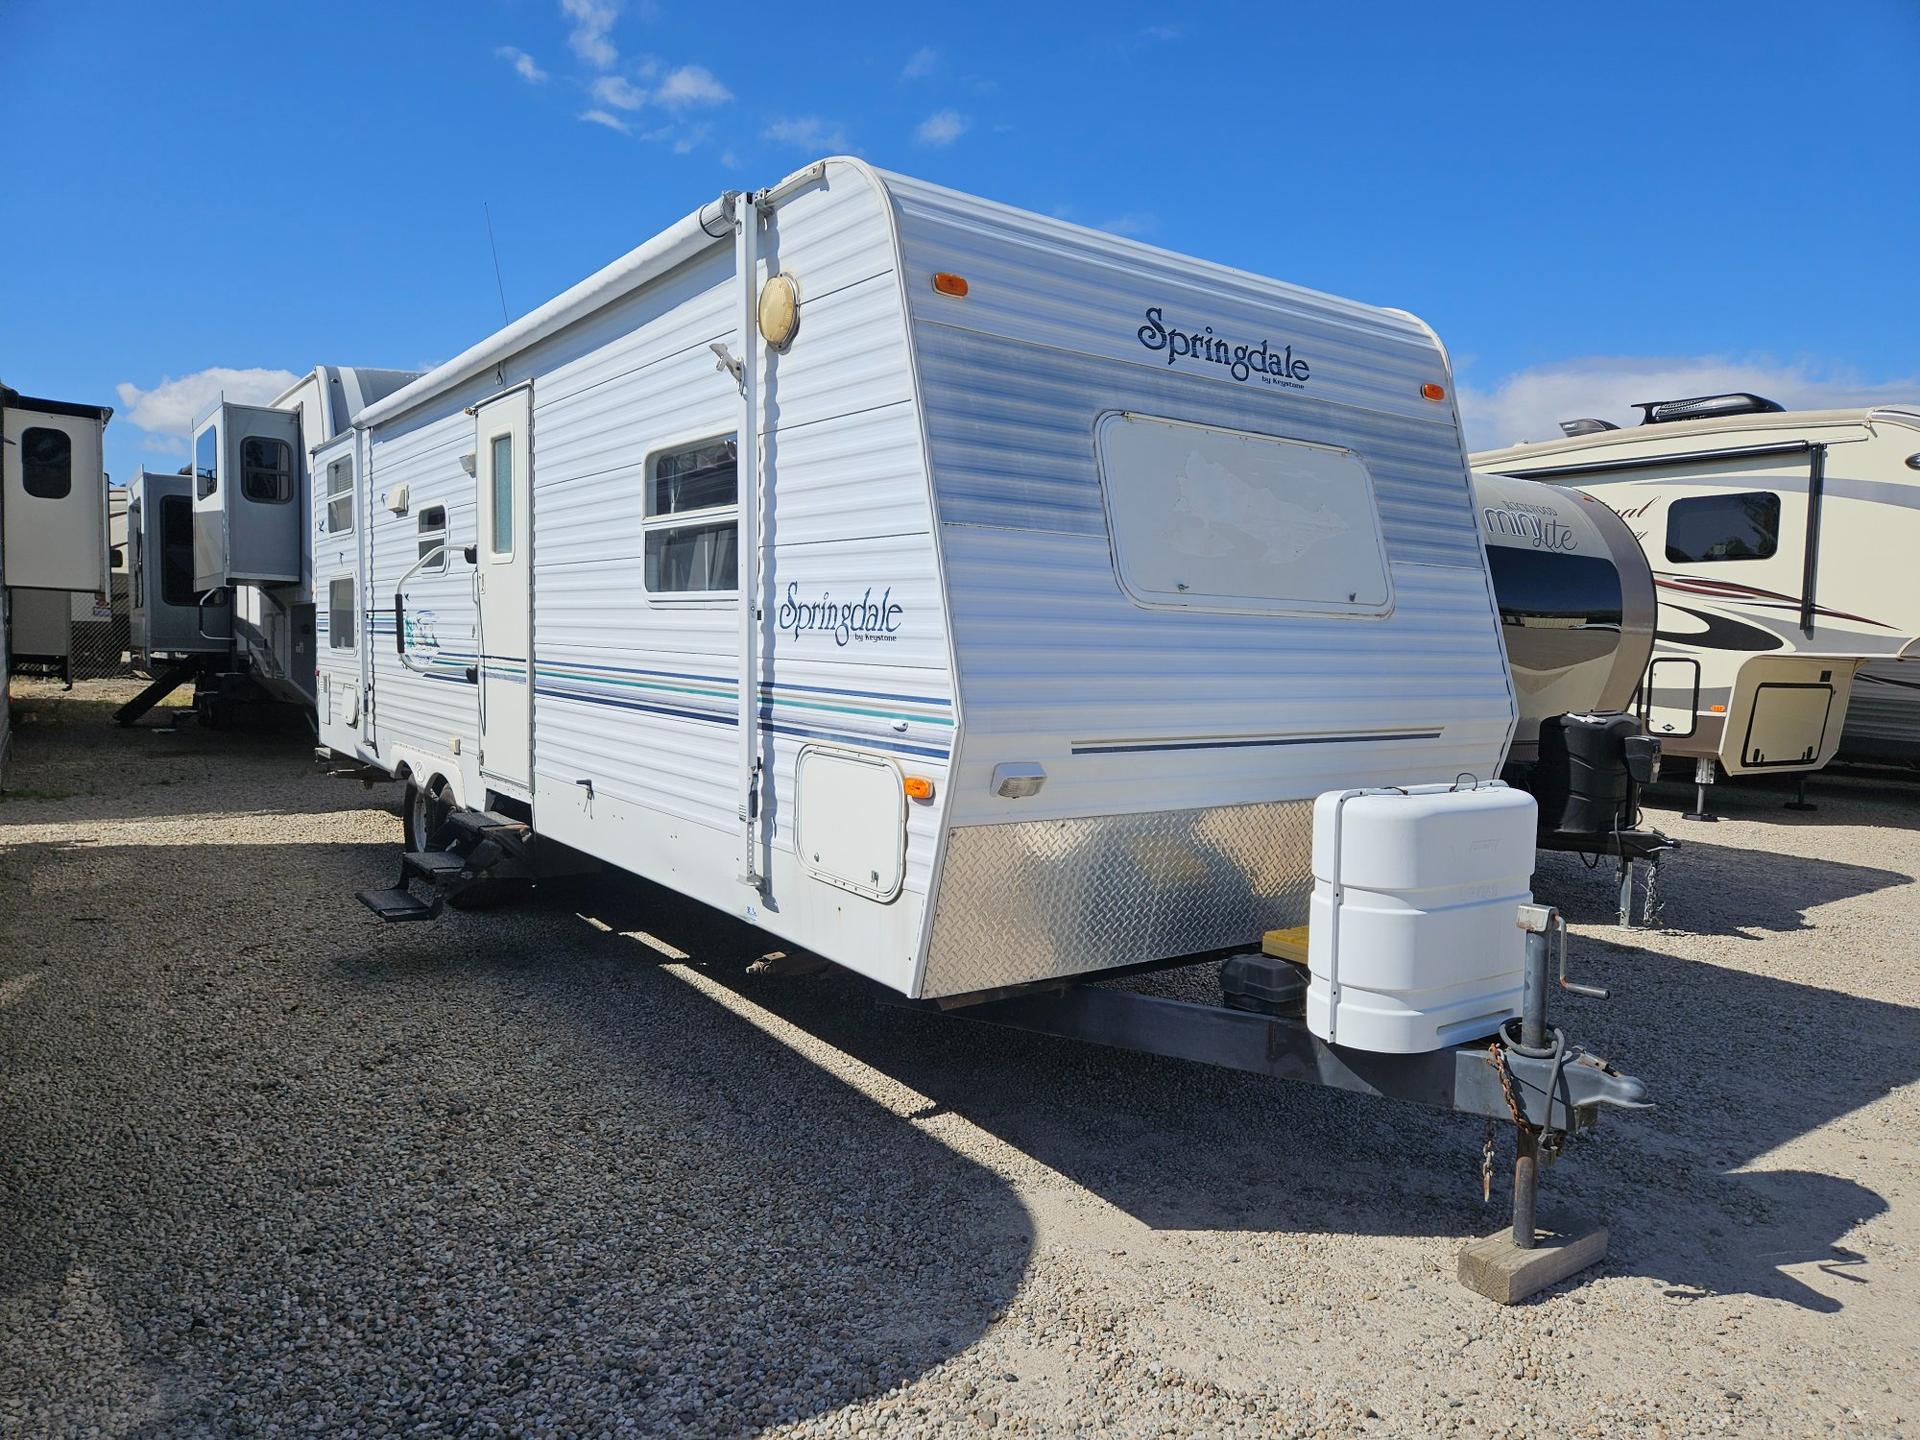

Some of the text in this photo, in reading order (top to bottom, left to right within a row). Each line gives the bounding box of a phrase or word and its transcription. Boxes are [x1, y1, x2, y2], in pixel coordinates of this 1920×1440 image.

[1137, 307, 1311, 382] Springdale
[1261, 375, 1271, 385] by
[779, 581, 904, 647] Springdale
[854, 633, 897, 643] by Keystone
